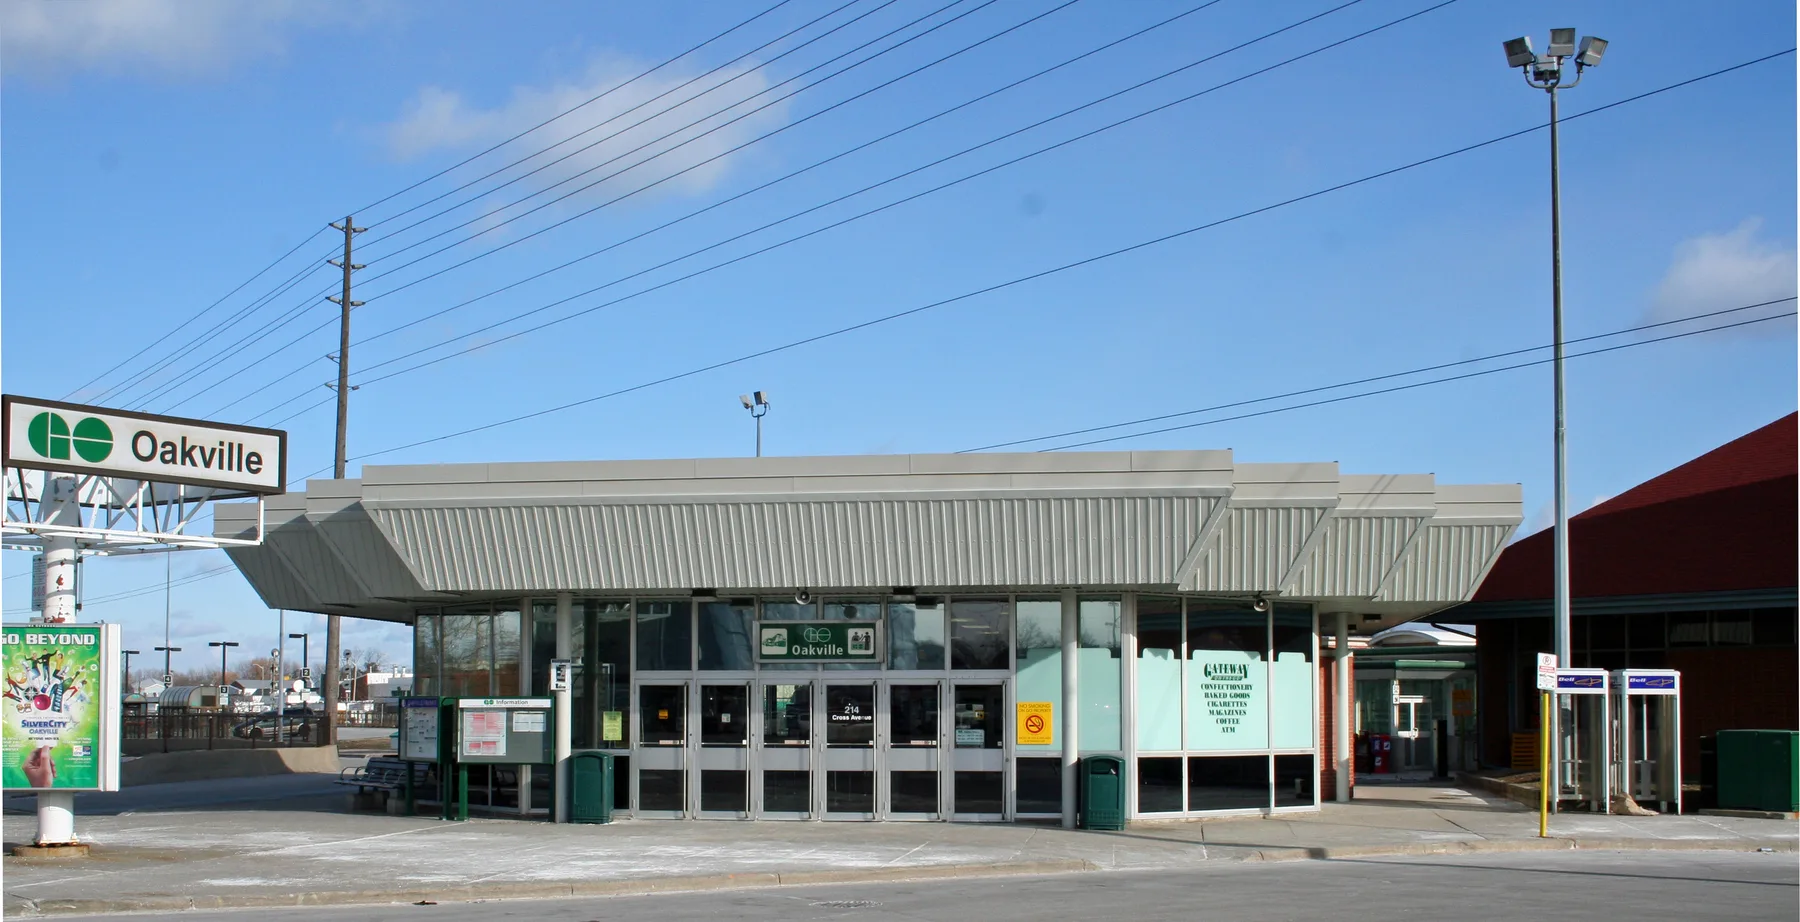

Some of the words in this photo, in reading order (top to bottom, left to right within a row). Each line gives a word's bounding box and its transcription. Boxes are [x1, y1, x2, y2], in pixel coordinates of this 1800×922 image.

[131, 430, 263, 475] Oakville
[26, 634, 95, 645] BEYOND
[792, 644, 843, 656] Oakville
[1204, 663, 1250, 679] GATEWAY
[1200, 683, 1253, 691] CONFECTIONERY
[844, 706, 860, 714] 214
